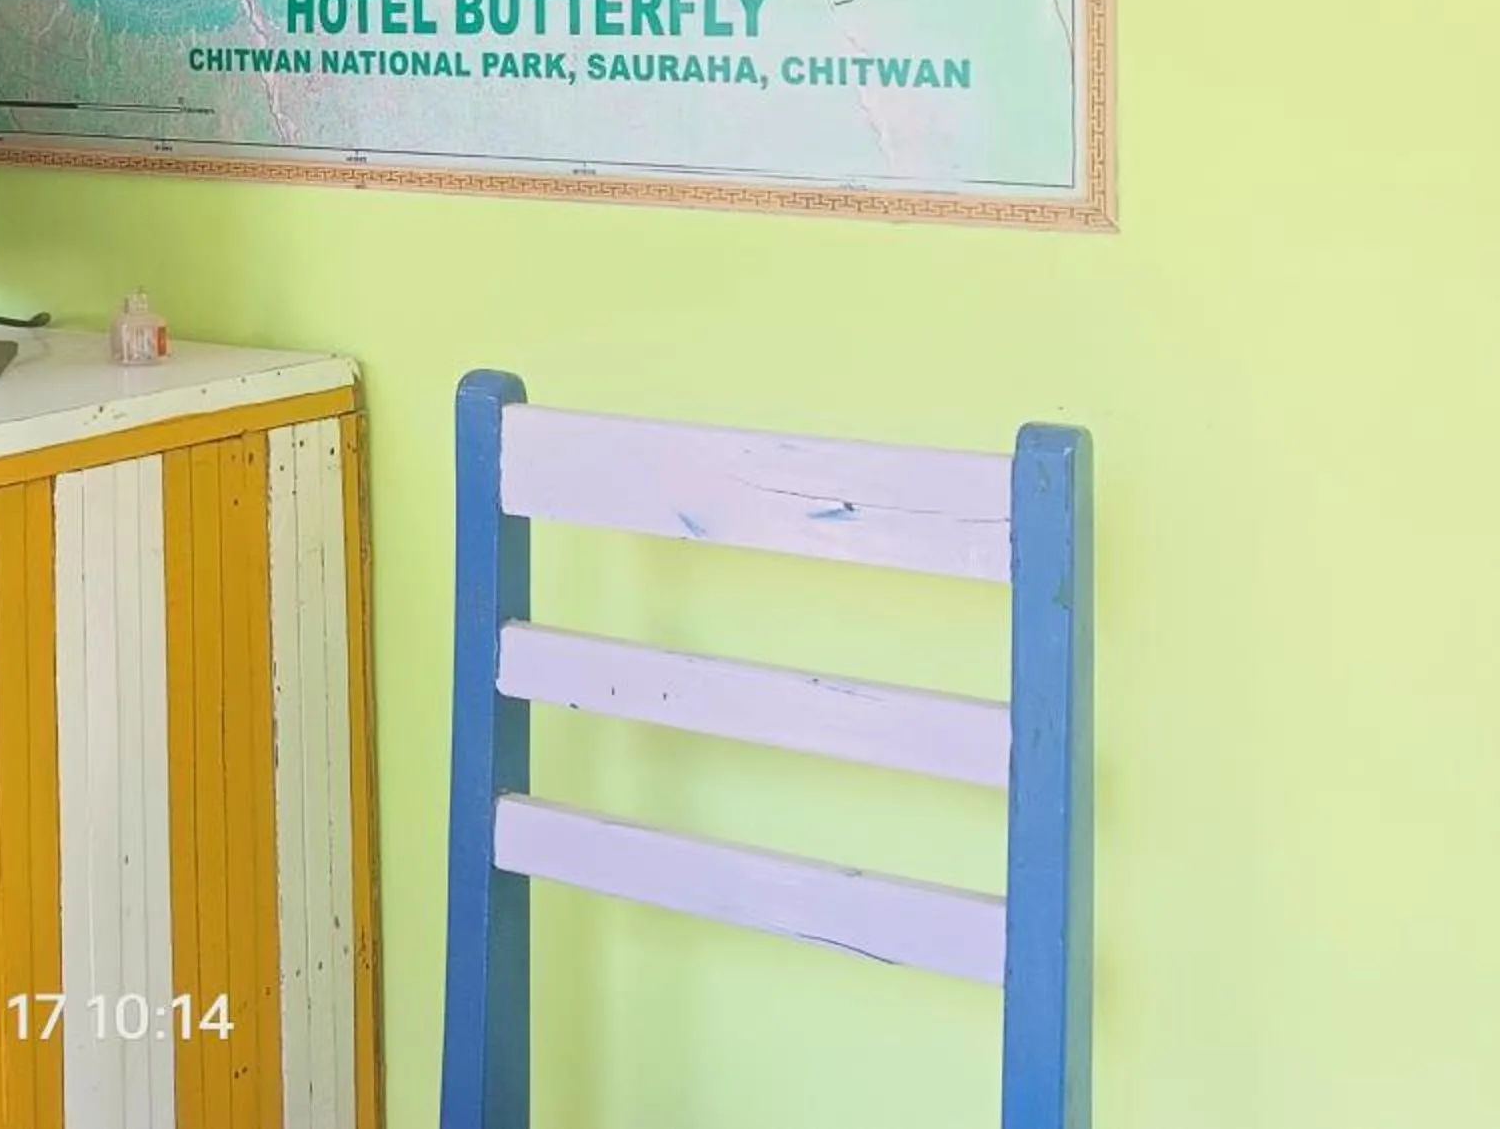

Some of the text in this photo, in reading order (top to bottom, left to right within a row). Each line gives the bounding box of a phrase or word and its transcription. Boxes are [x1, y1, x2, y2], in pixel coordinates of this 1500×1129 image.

[188, 47, 972, 91] CHITWAN NATIONAL PARK, SAURAHA, CHITWAN
